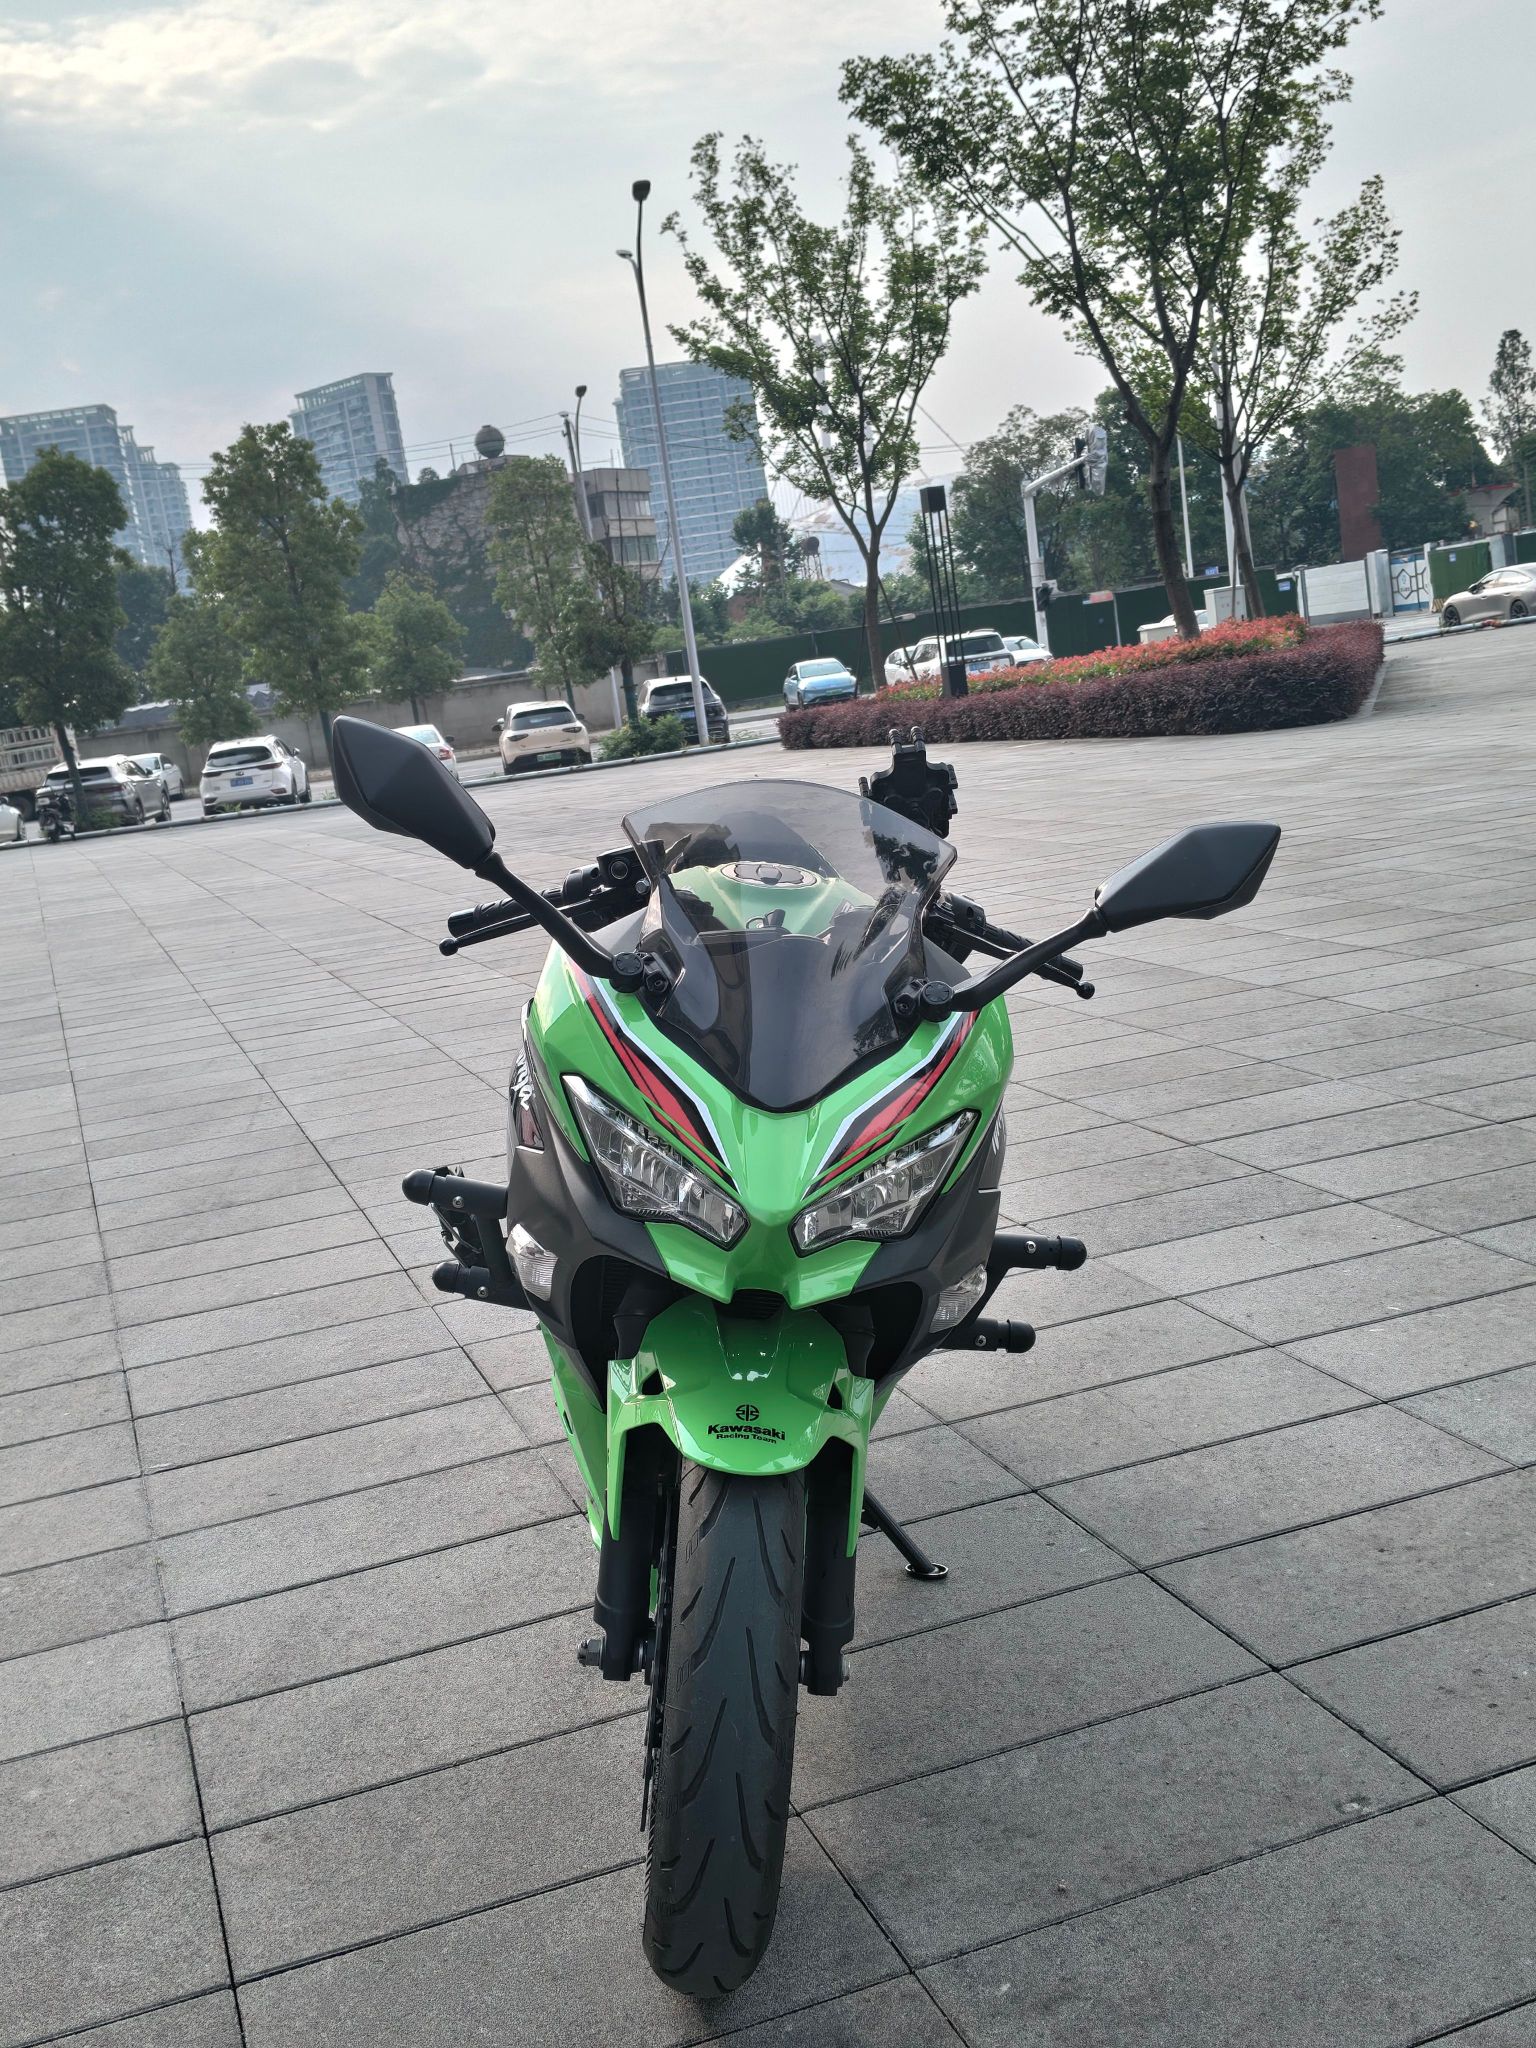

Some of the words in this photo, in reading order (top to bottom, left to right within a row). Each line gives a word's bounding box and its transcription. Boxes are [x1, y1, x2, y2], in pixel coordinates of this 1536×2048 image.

[708, 1424, 786, 1440] Kawasaki
[716, 1432, 750, 1440] Racing
[752, 1434, 777, 1444] Team
